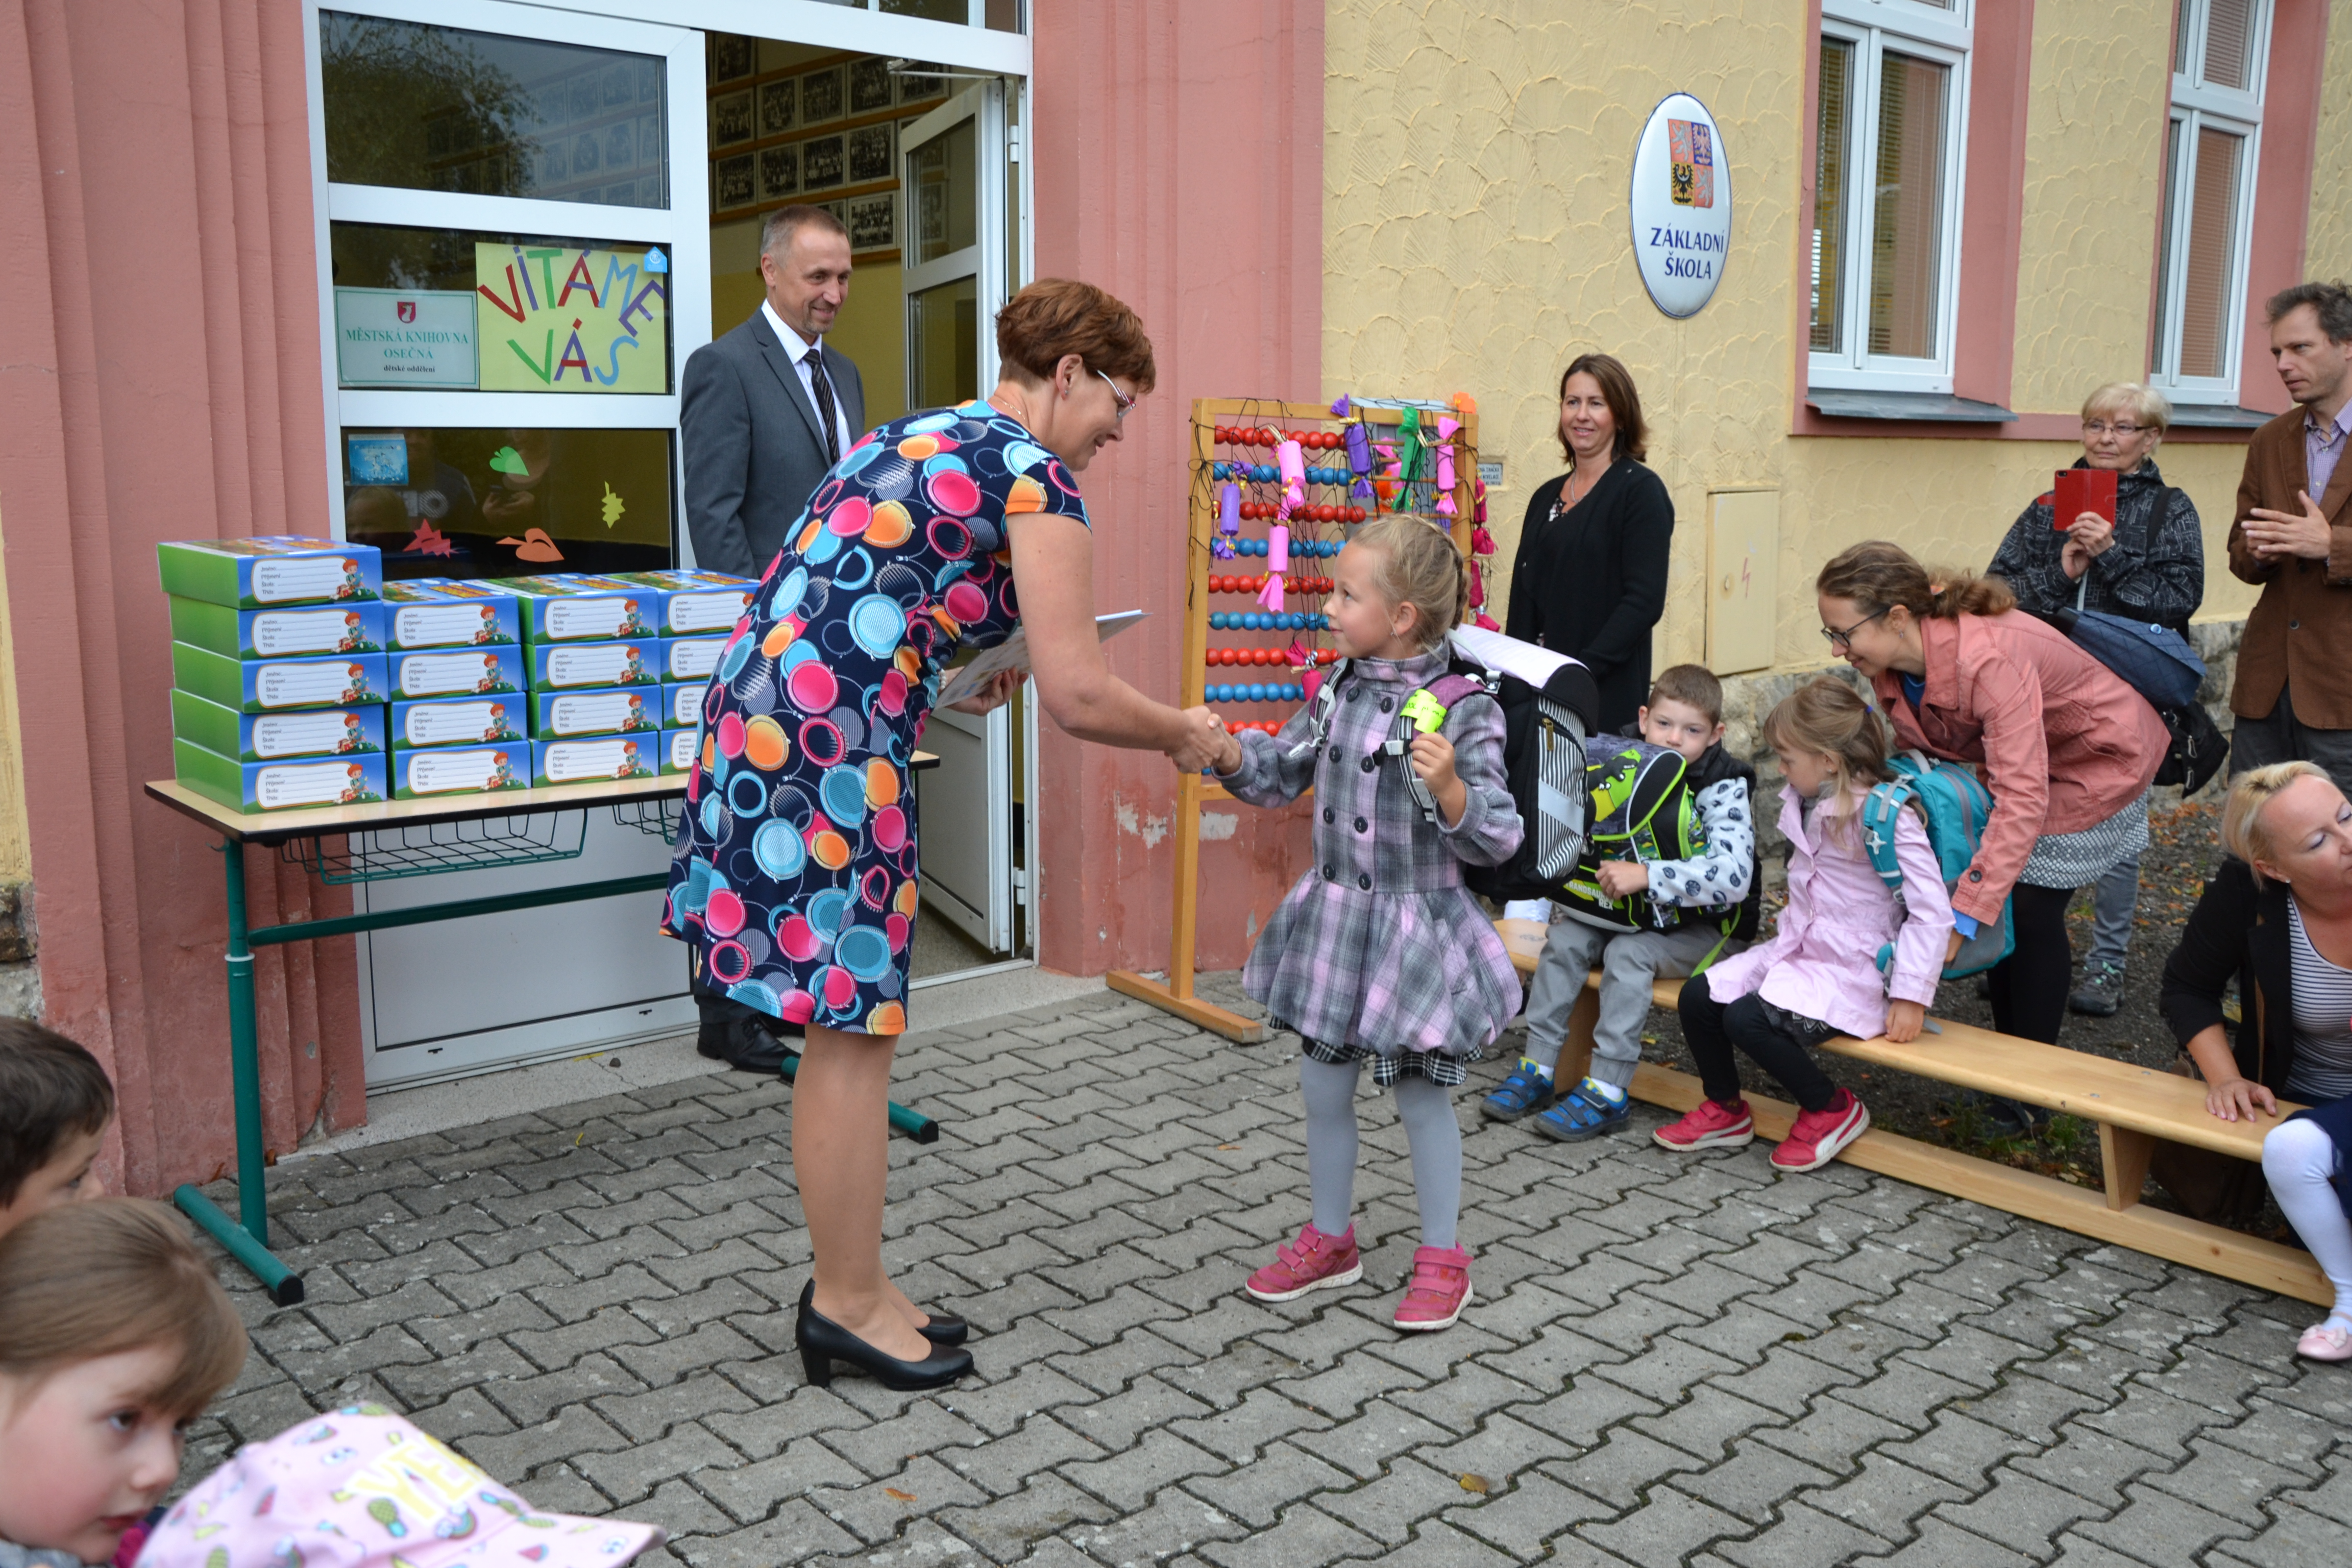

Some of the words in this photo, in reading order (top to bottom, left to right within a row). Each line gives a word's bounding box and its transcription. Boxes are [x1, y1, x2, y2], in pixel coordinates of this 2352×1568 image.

[1650, 223, 1724, 253] ZÁKLADNÍ
[1664, 251, 1712, 280] ŠKOLA
[346, 327, 402, 341] MĚSTSKÁ
[406, 331, 469, 344] KNIHOVNA
[384, 347, 434, 359] OSEČNÁ
[506, 317, 639, 386] VÁS
[1598, 898, 1614, 911] REX
[351, 1432, 487, 1521] YE
